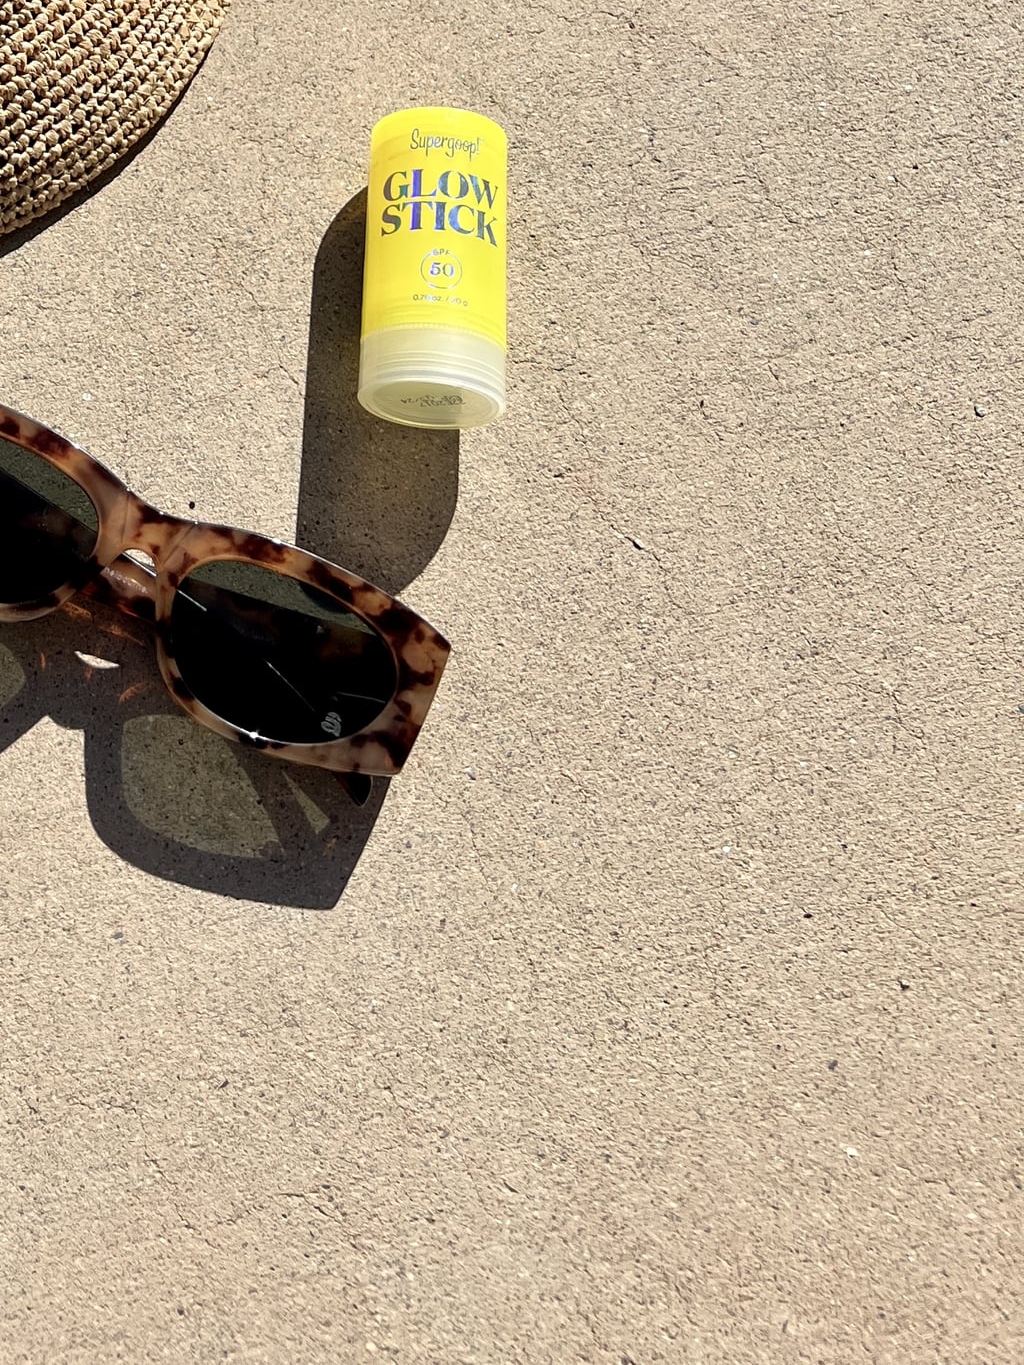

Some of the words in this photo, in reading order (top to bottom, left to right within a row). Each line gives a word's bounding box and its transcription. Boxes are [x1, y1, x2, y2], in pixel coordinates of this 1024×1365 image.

[410, 128, 480, 162] Supergoop!
[383, 169, 499, 210] GLOW
[380, 201, 498, 247] STICK
[432, 248, 451, 256] SPF
[430, 262, 454, 277] 50
